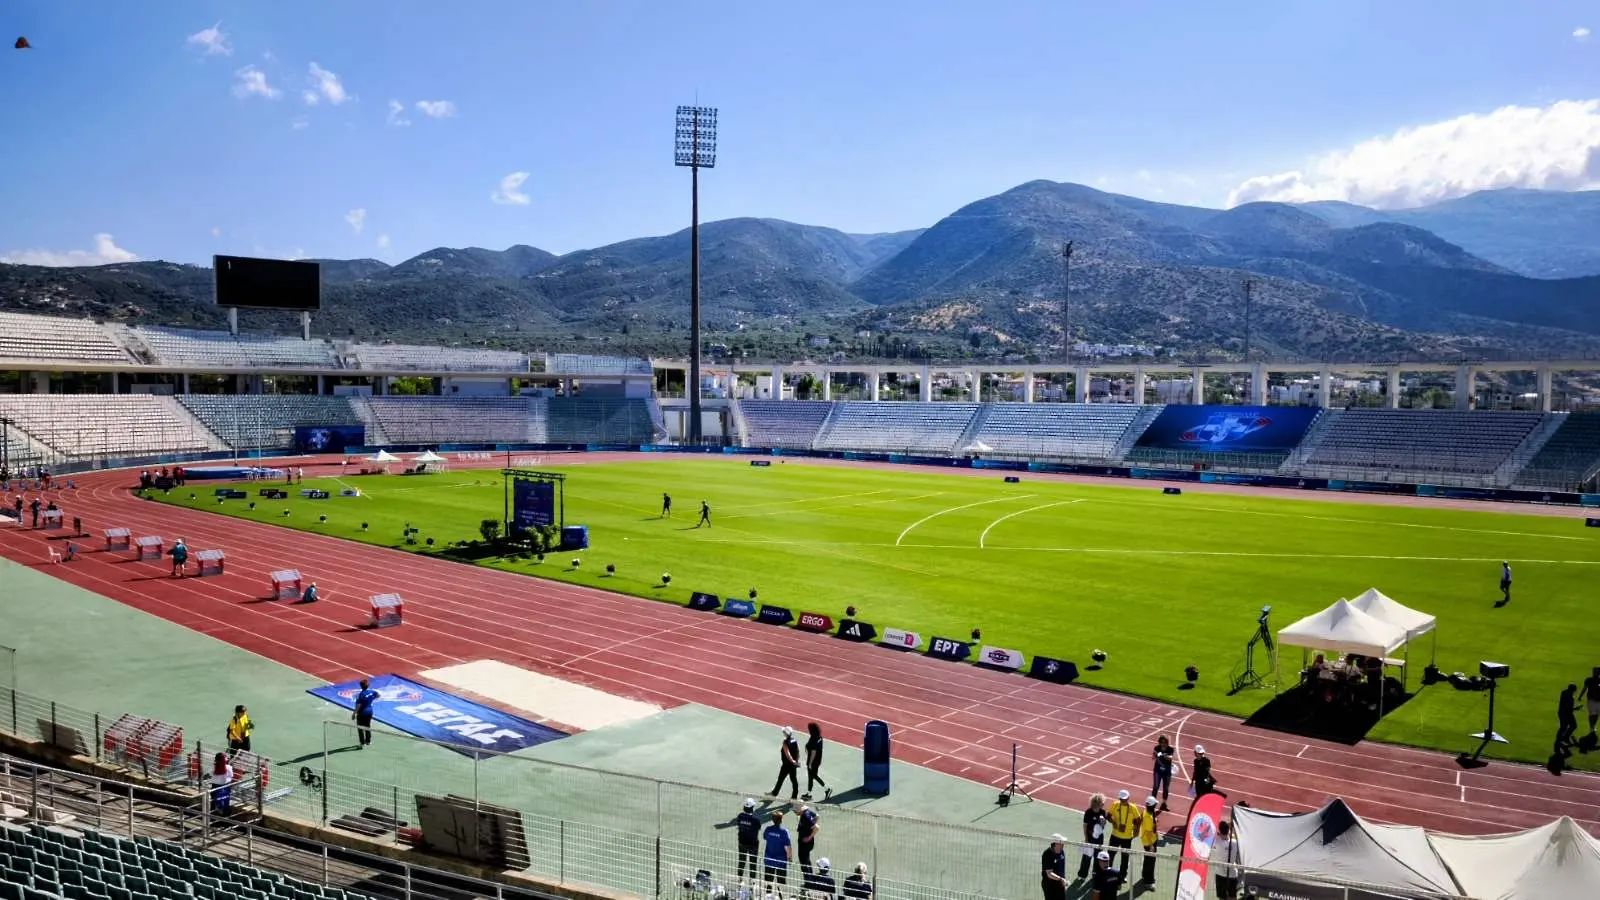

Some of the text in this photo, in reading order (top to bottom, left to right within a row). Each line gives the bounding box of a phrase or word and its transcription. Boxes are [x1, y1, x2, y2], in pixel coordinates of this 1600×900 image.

[801, 615, 824, 626] ERGO
[1141, 717, 1163, 726] 2
[1124, 726, 1144, 734] 3
[1103, 735, 1121, 744] 4
[1081, 745, 1104, 754] 5
[1058, 756, 1081, 765] 6
[1032, 766, 1058, 776] 7
